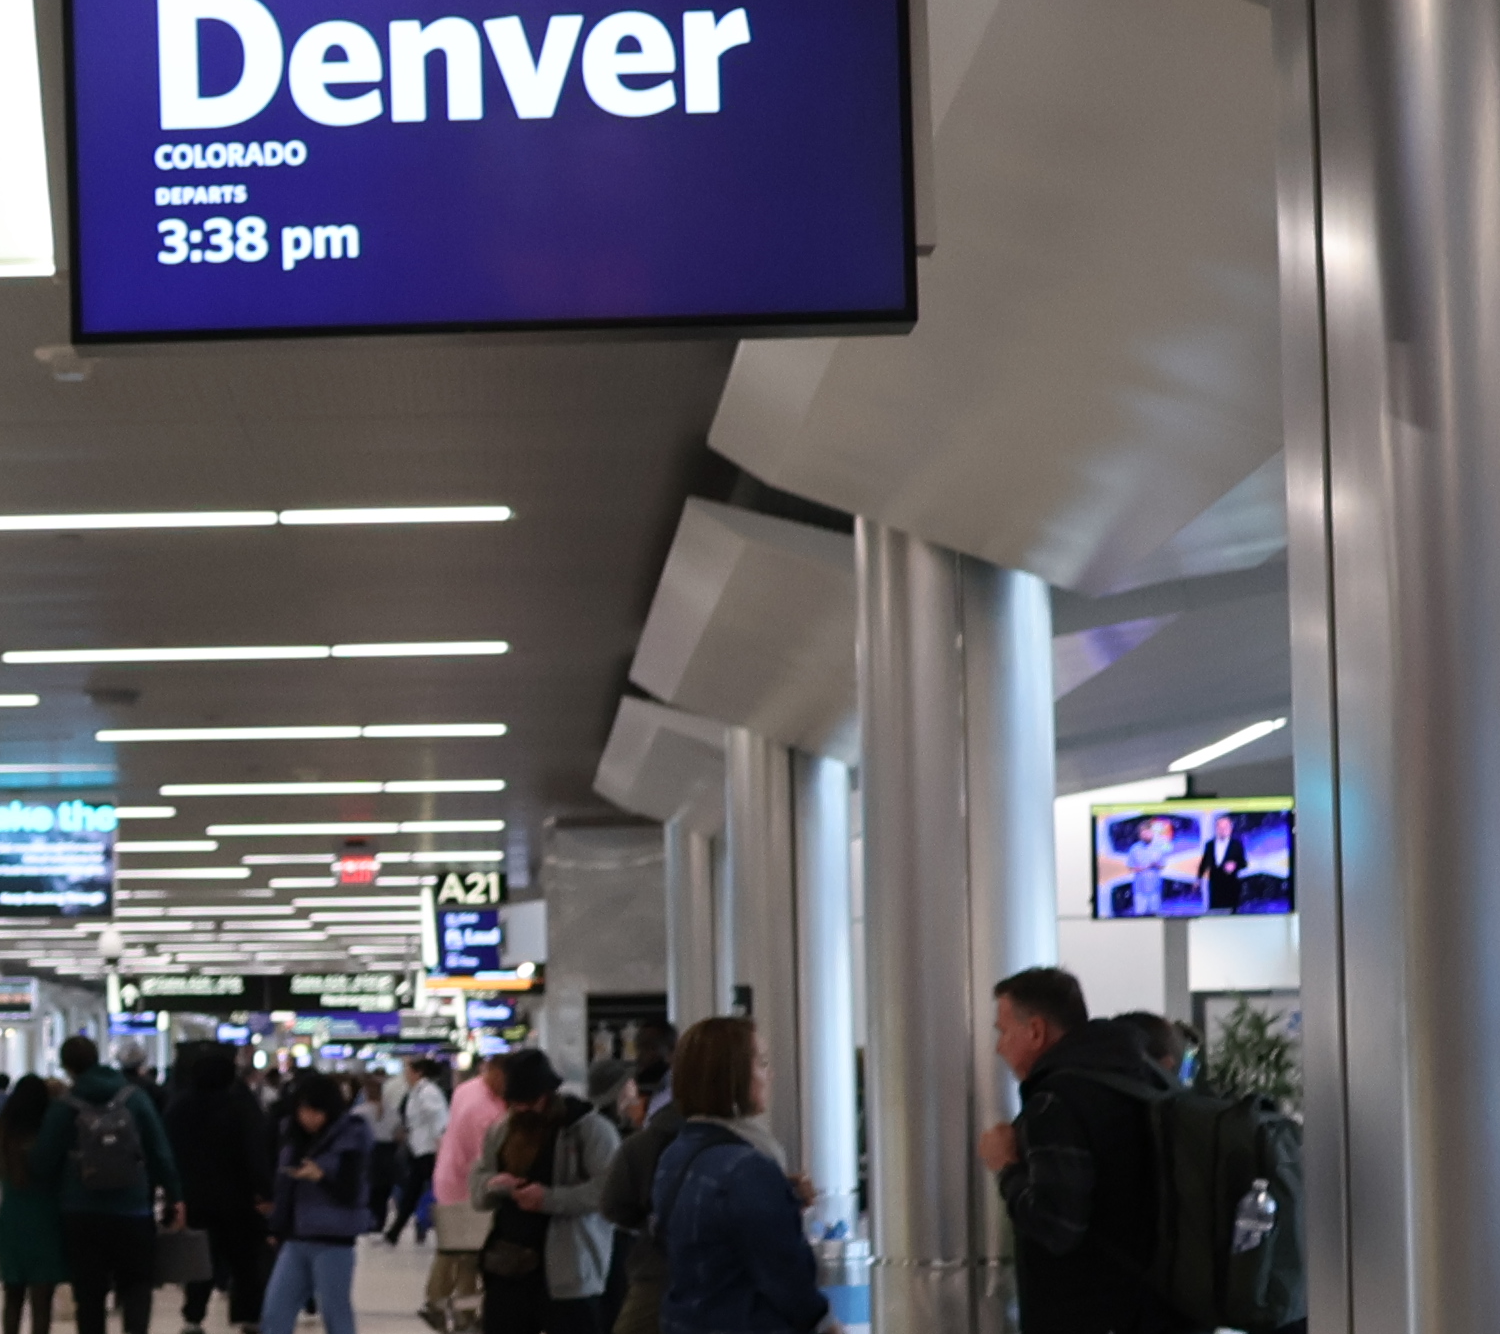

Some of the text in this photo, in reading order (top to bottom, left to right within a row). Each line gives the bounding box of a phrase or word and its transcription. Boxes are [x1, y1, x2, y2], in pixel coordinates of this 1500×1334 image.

[154, 140, 307, 171] COLORADO
[155, 184, 248, 206] DEPARTS
[157, 219, 360, 272] 3:38 pm
[57, 799, 119, 833] the
[438, 871, 501, 905] A21
